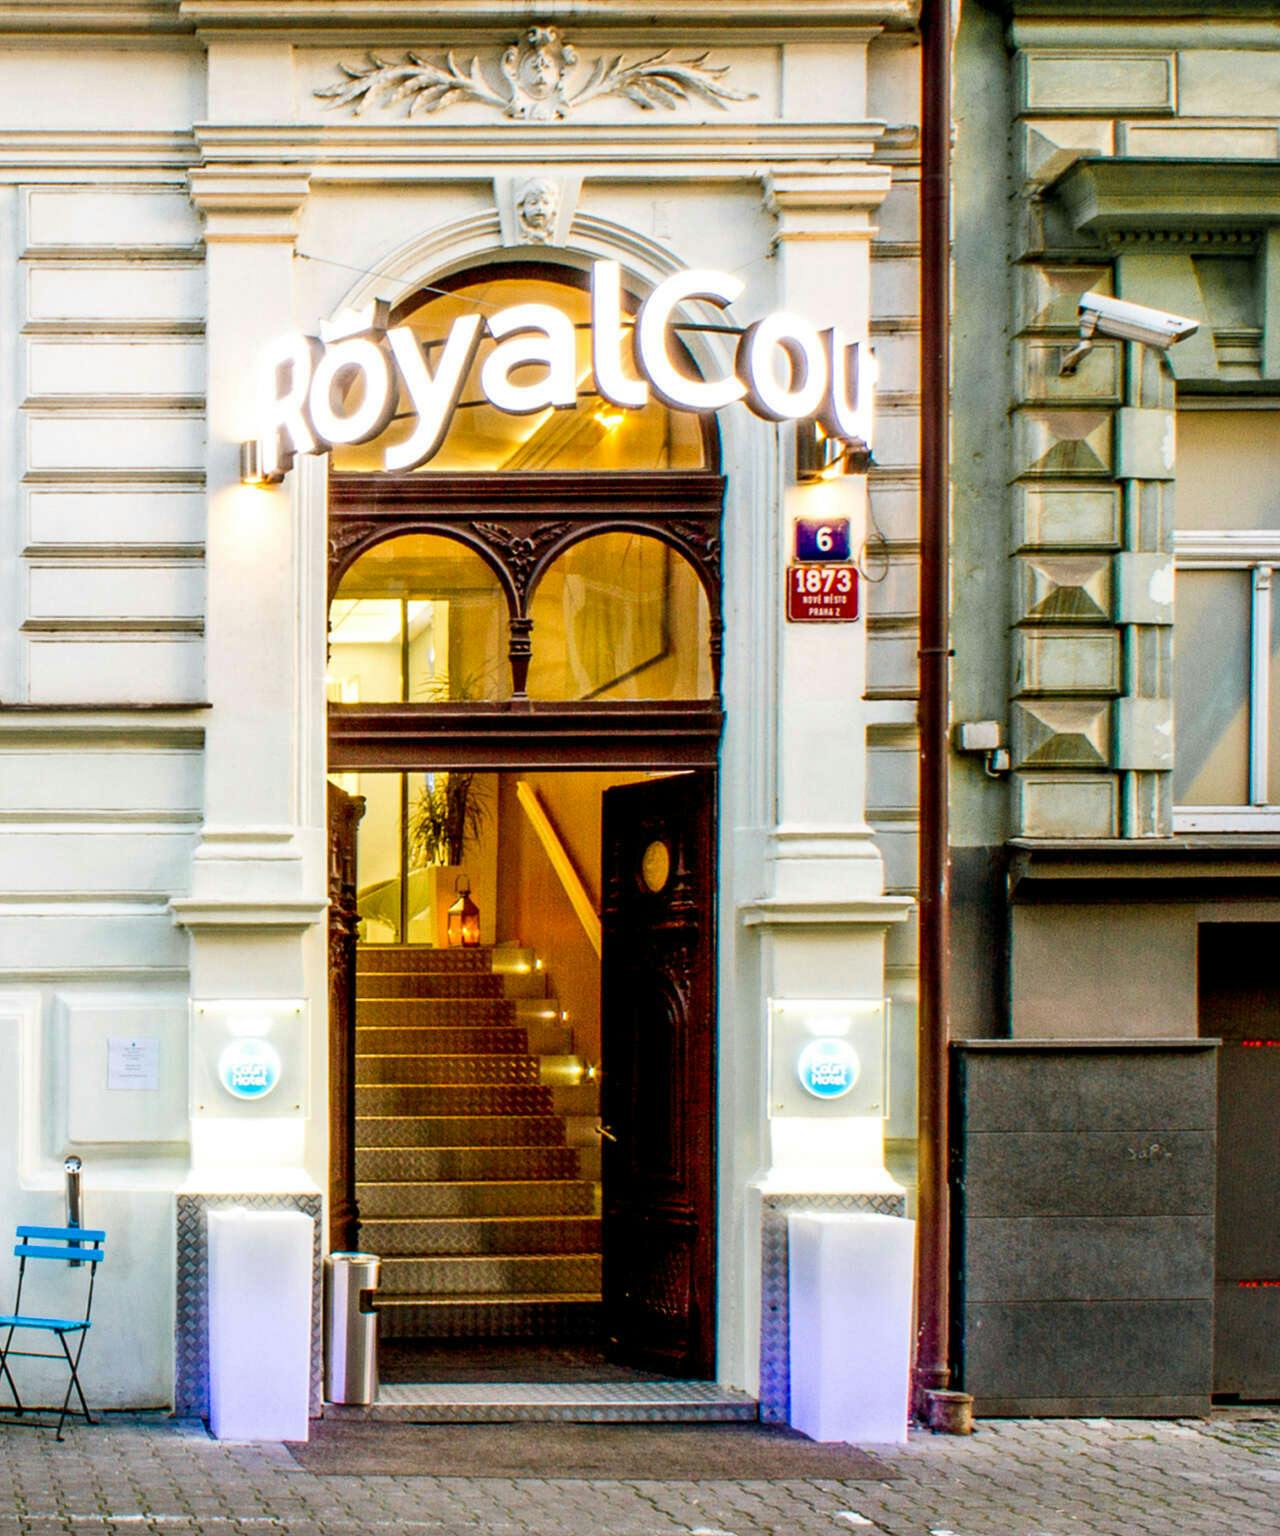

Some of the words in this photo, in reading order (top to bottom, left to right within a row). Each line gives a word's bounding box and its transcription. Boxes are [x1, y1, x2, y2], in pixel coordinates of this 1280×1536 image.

[816, 526, 833, 552] 6
[796, 569, 852, 593] 1873
[808, 607, 834, 616] PRAHA
[834, 607, 841, 616] 2
